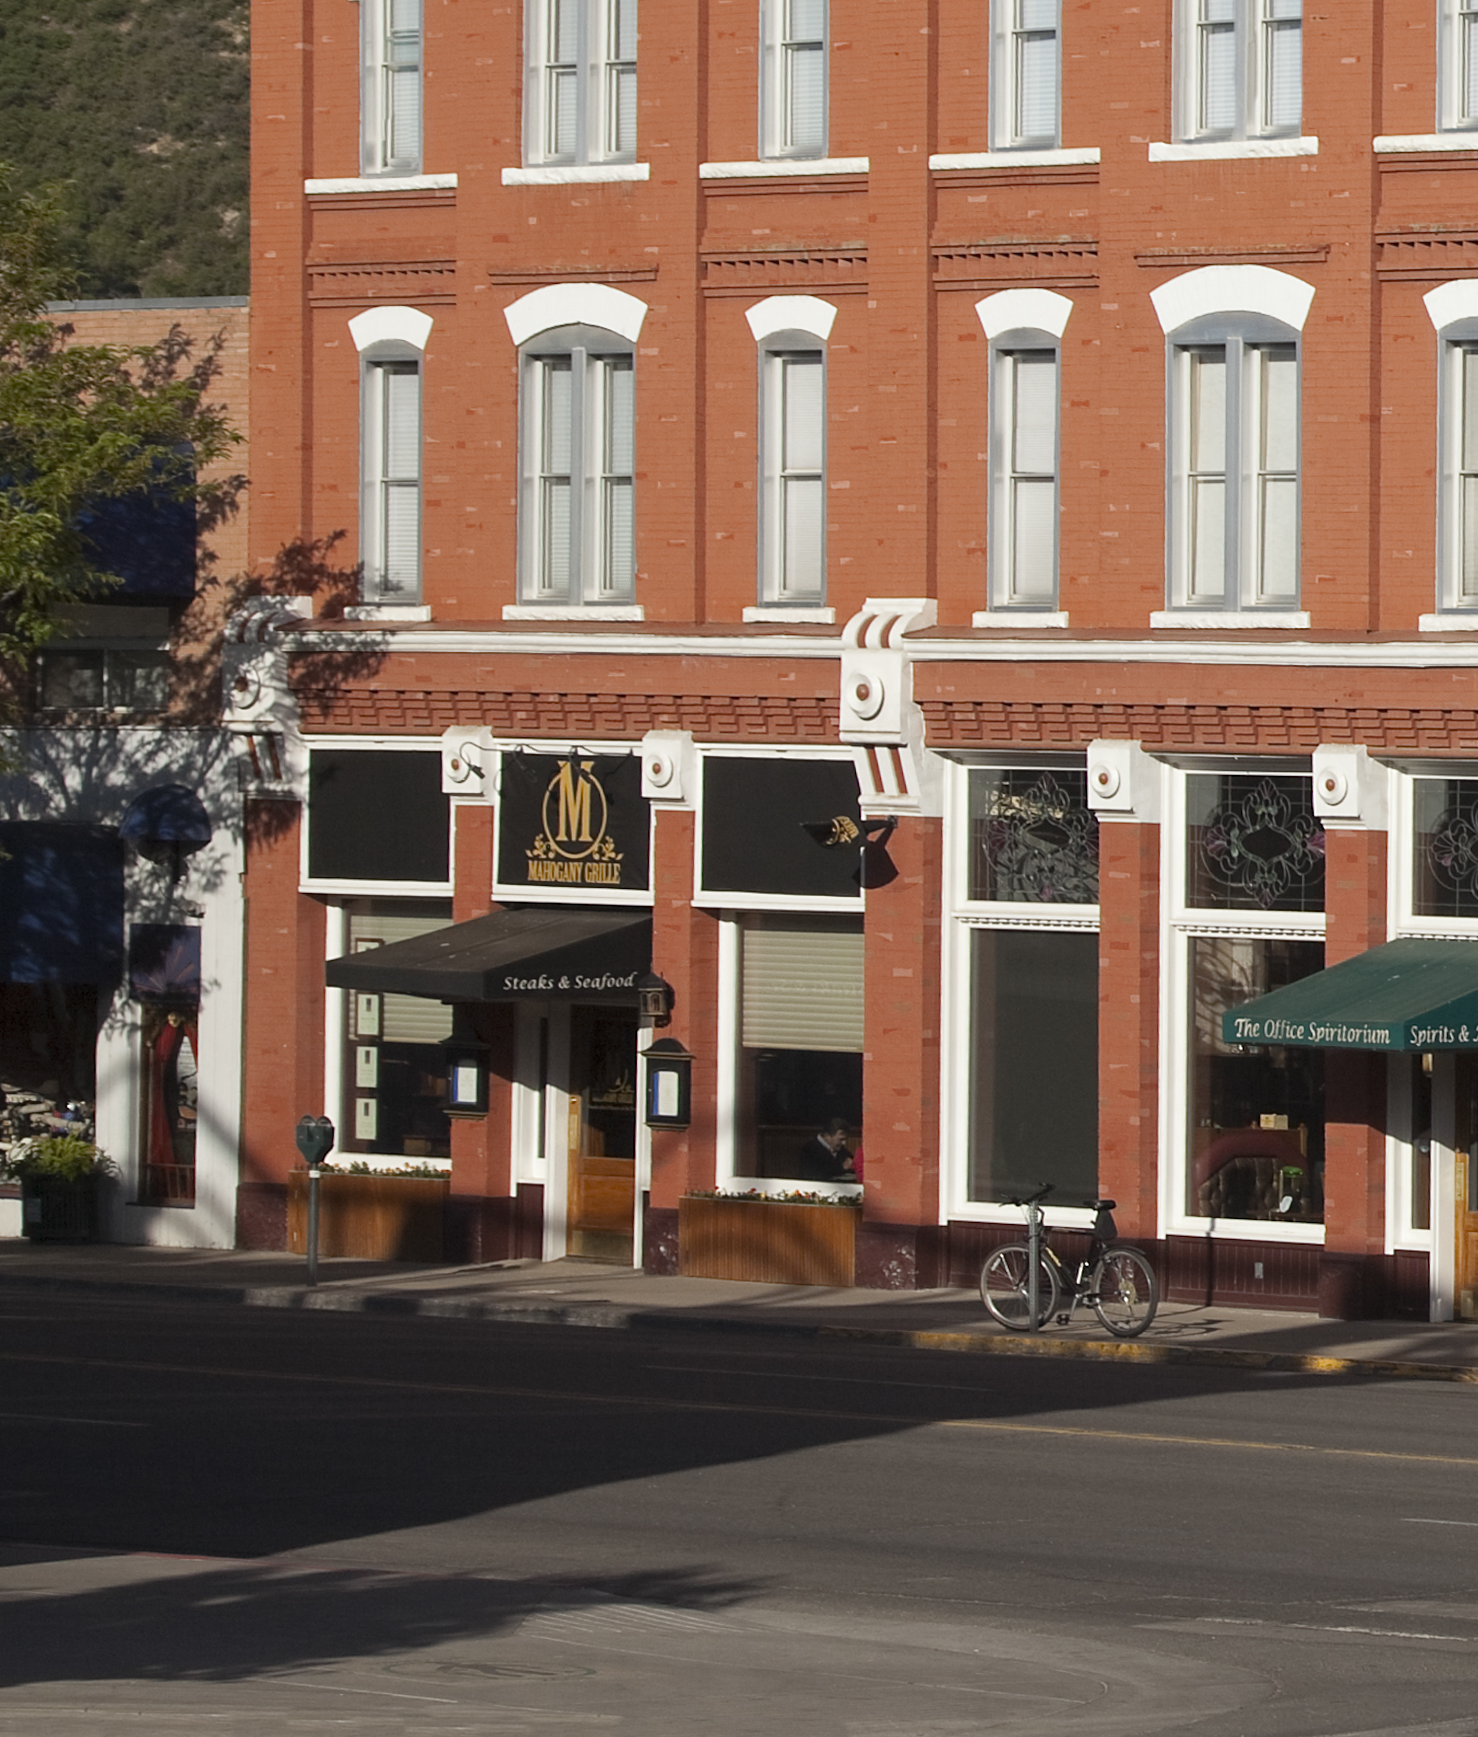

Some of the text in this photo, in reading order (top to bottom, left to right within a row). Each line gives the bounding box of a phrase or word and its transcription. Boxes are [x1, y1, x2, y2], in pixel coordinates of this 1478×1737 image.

[555, 760, 594, 841] M
[527, 860, 621, 884] MAHOGANY GRILLE
[503, 972, 638, 990] Steaks & Seafood
[1234, 1018, 1390, 1044] The Office Spiritorium
[1410, 1025, 1455, 1047] Spirits
[1458, 1025, 1470, 1042] &
